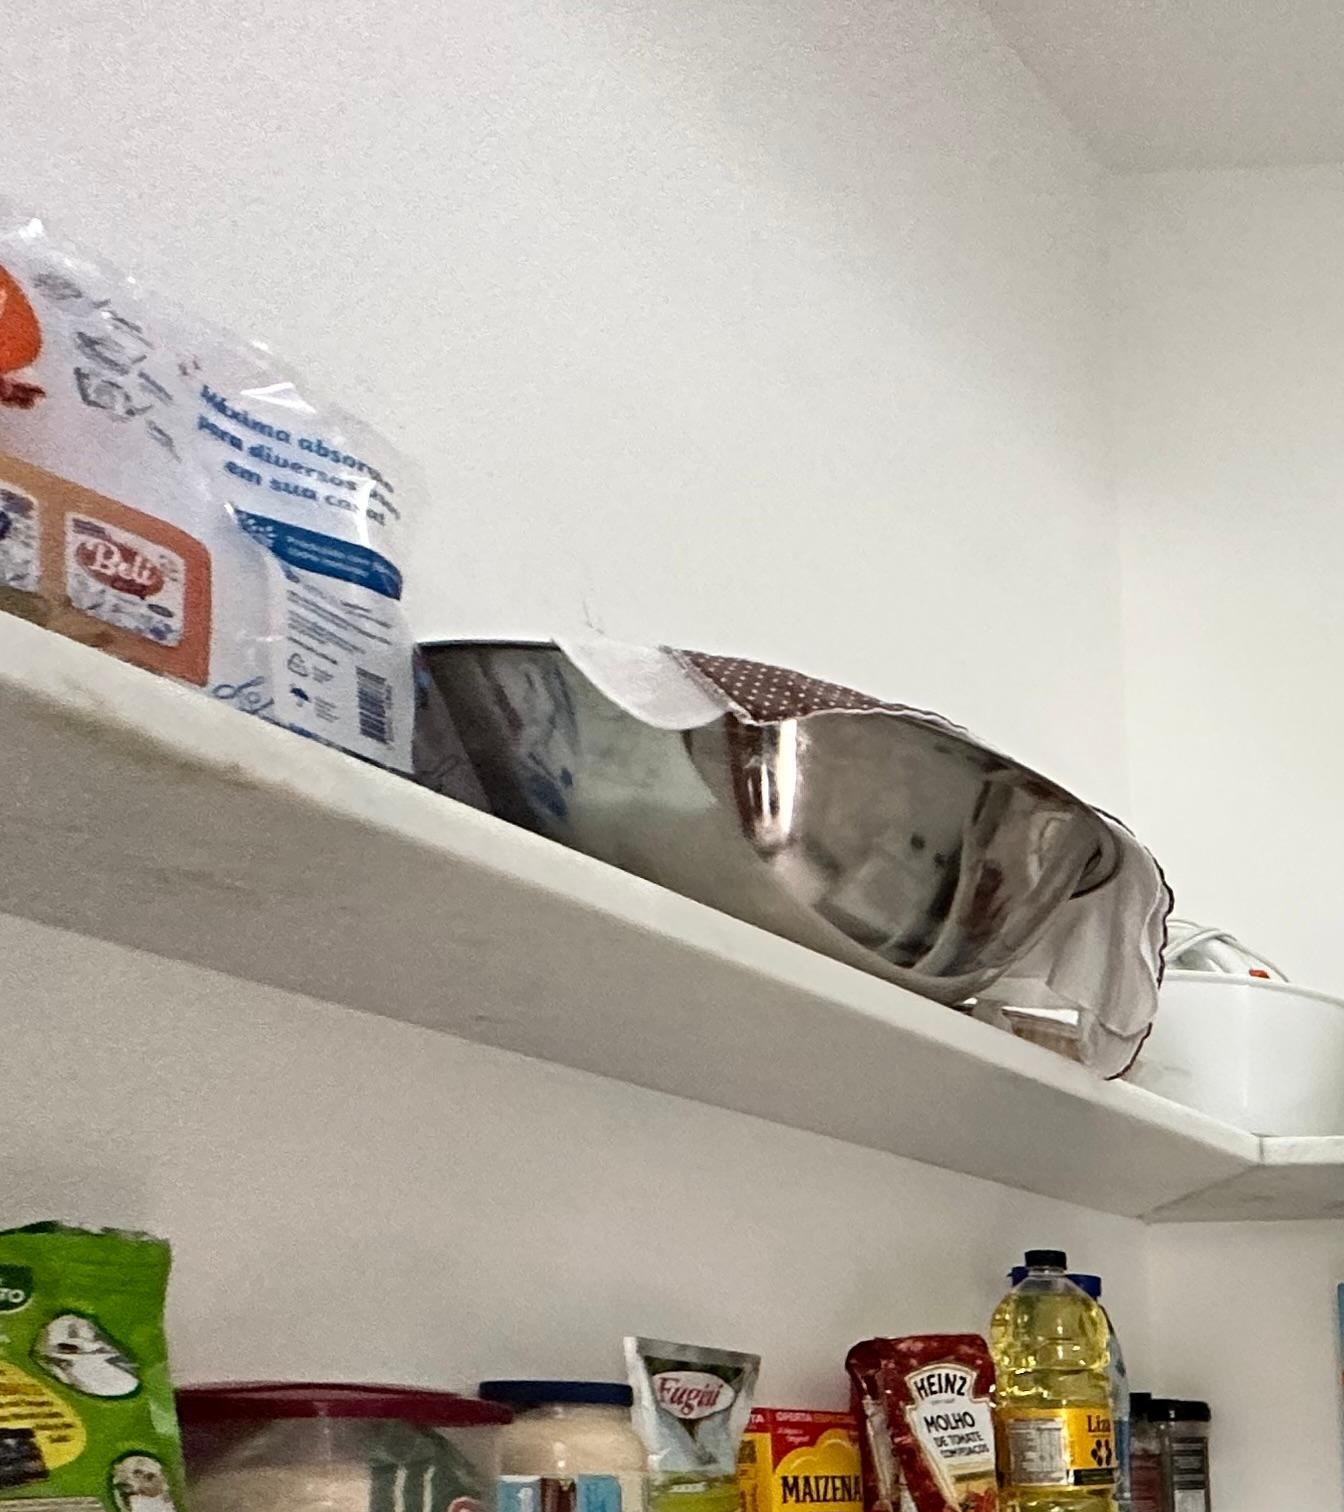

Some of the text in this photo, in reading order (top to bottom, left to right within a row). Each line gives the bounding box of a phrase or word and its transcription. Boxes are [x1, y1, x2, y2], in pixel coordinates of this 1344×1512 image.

[913, 1373, 967, 1400] HEINZ
[923, 1411, 976, 1433] MOLHO
[781, 1475, 862, 1504] MAIZENA
